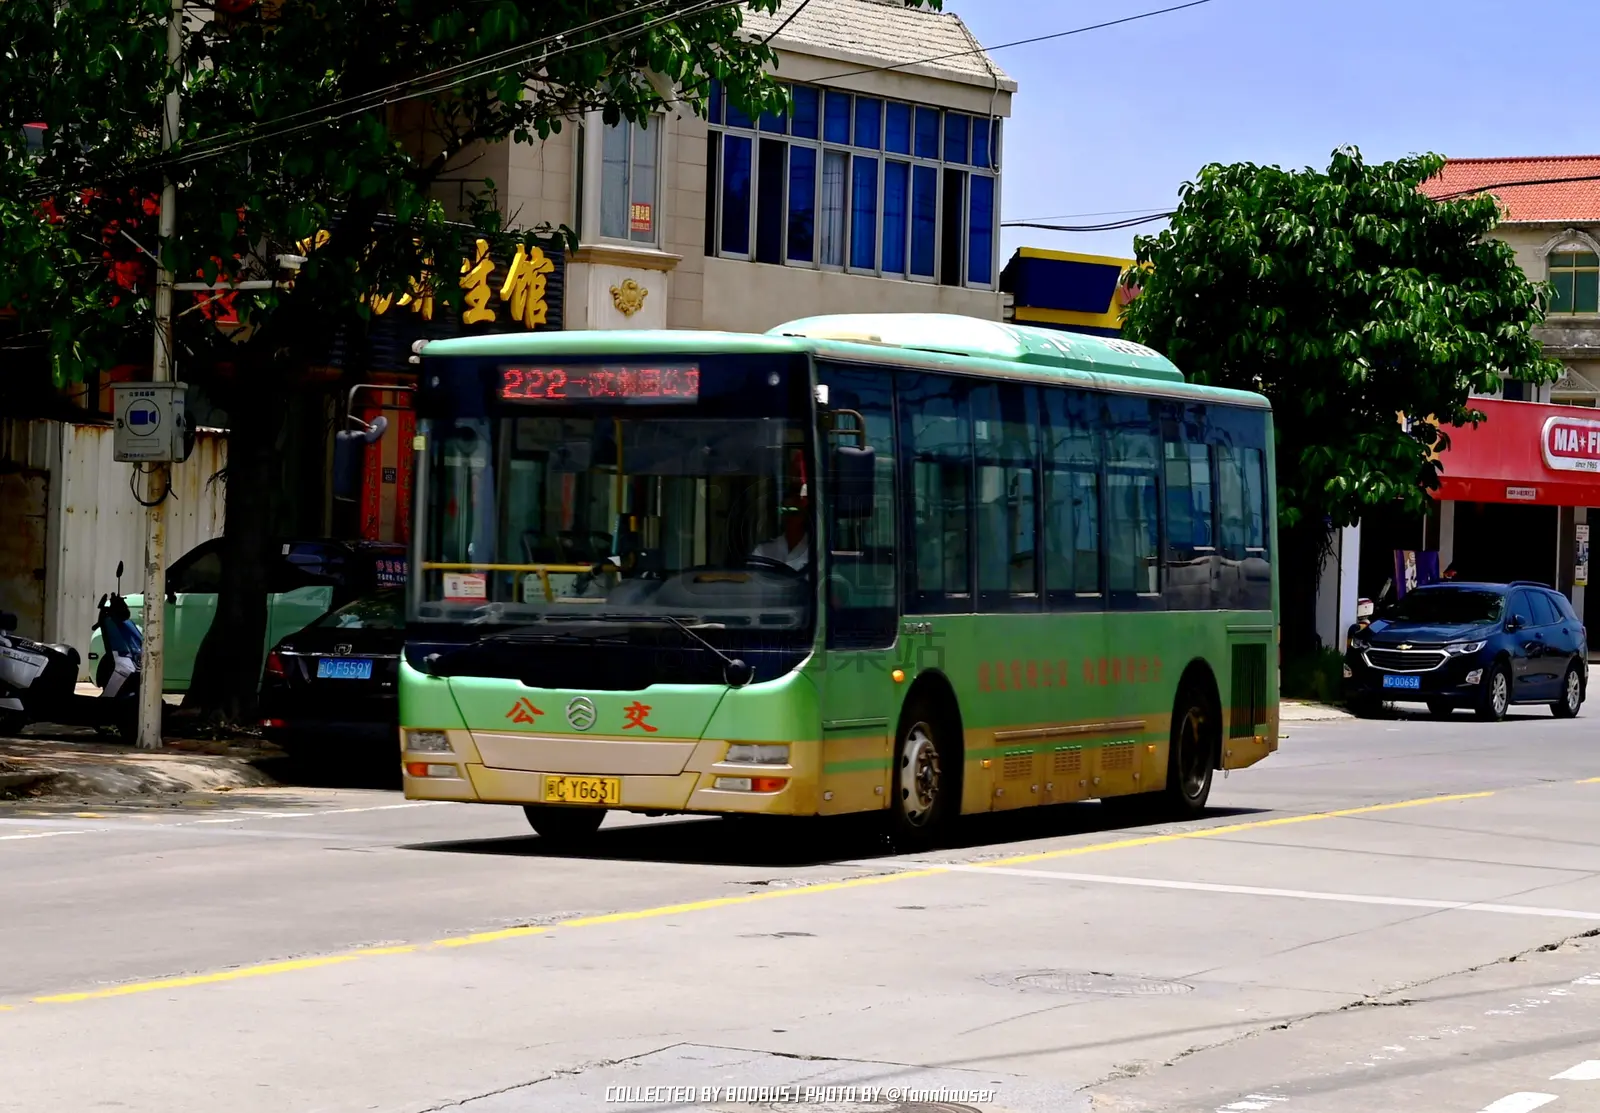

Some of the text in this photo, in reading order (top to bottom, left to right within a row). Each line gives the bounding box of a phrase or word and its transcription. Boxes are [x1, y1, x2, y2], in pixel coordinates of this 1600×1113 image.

[502, 368, 568, 399] 222
[505, 696, 659, 733] 公 交
